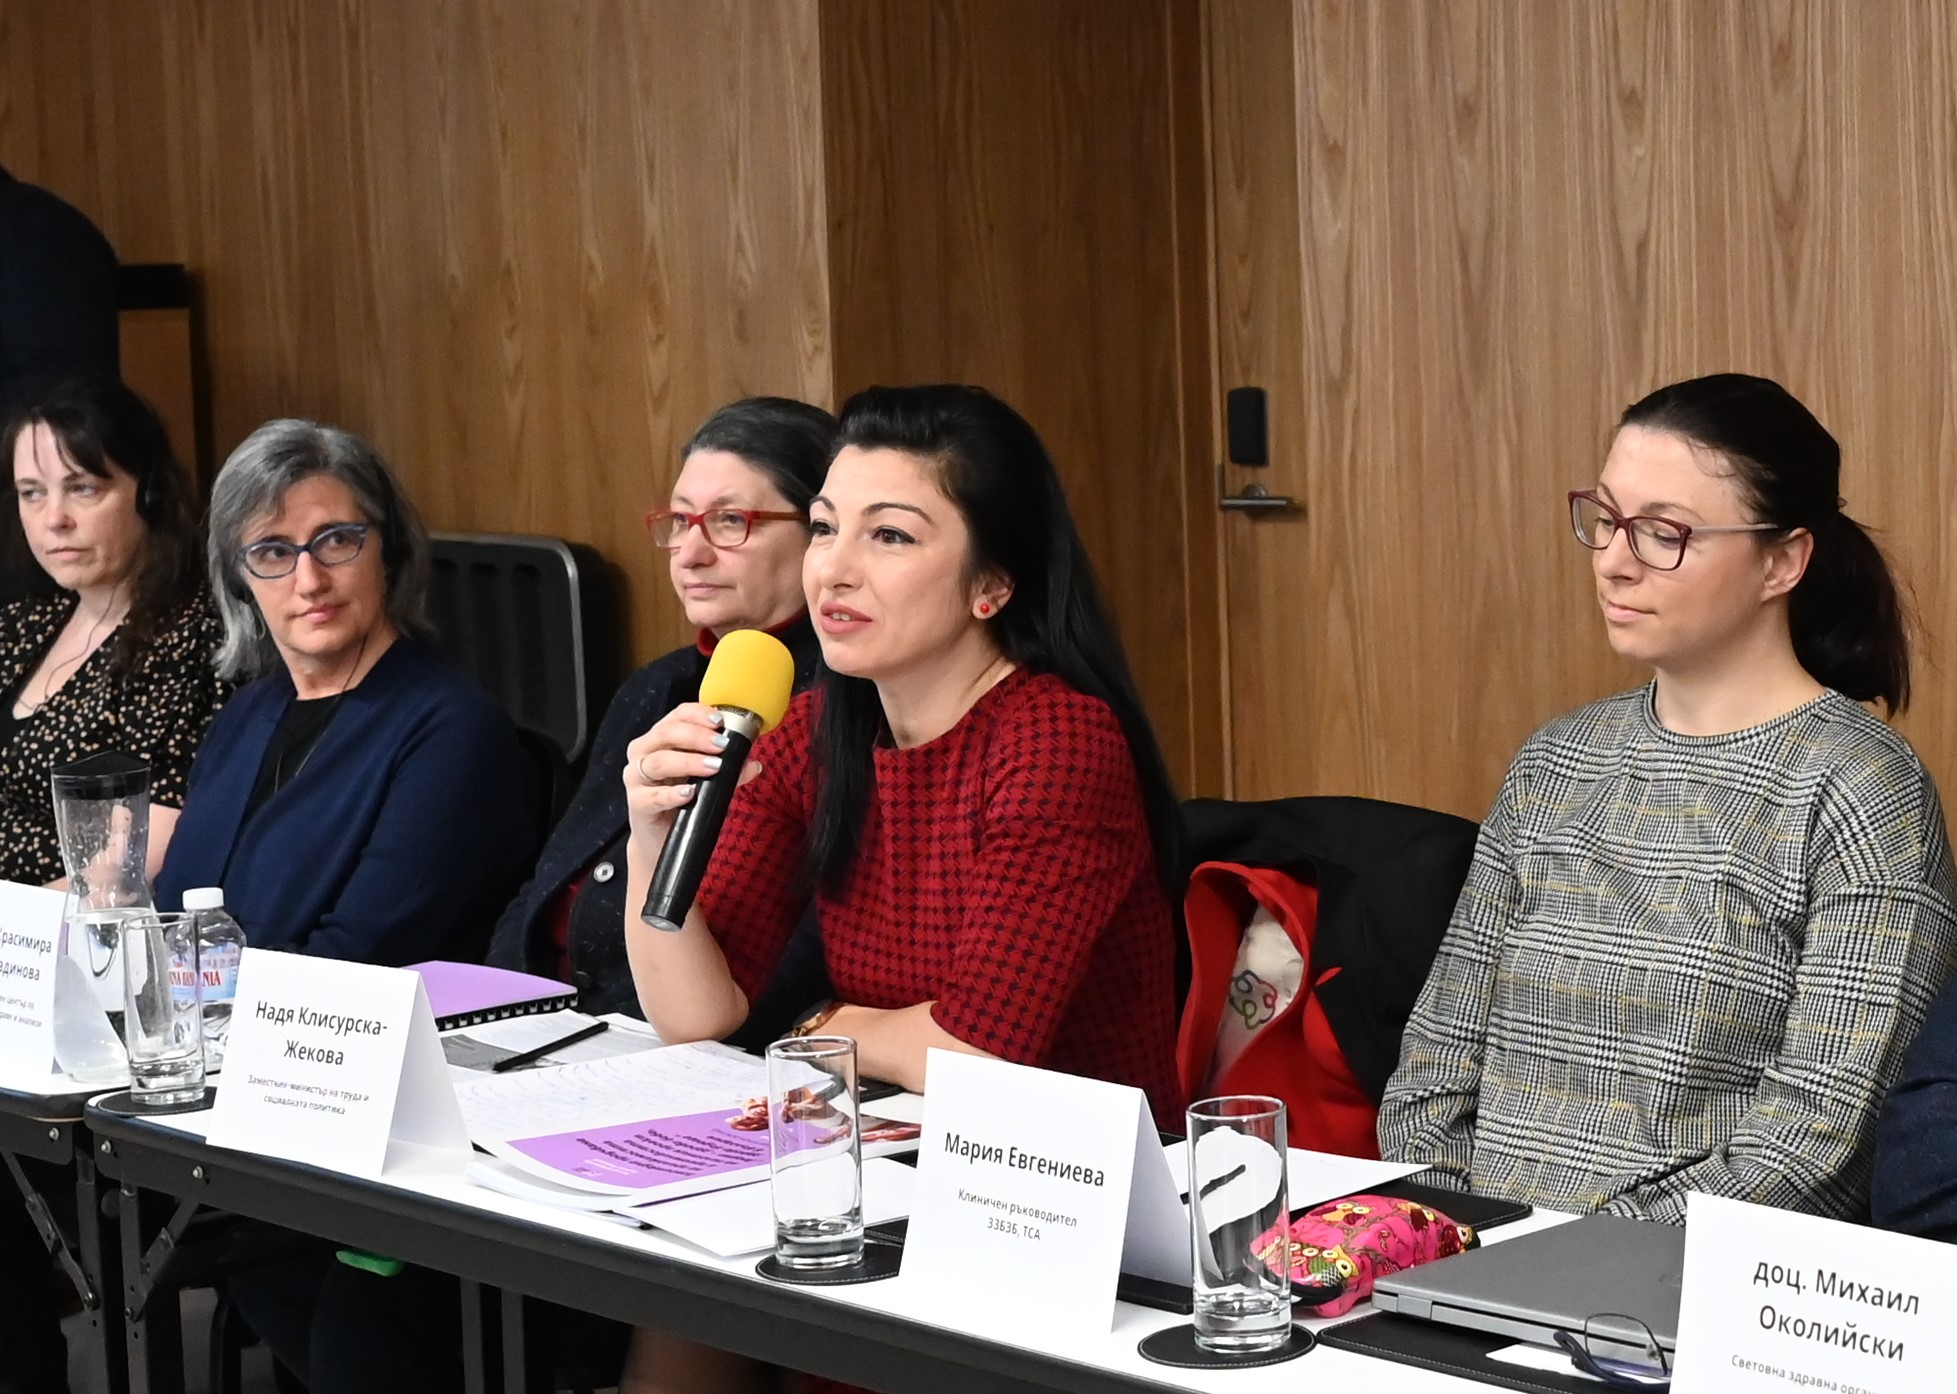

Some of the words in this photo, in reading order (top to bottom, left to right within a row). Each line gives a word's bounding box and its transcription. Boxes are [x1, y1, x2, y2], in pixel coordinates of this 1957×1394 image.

[0, 927, 52, 957] расимира
[256, 1000, 295, 1026] Надя
[298, 1006, 388, 1037] Клисурска-
[284, 1039, 345, 1065] Жекова
[945, 1132, 1003, 1165] Мария
[1008, 1146, 1105, 1187] Евгениева
[958, 1188, 1008, 1211] Клиничен
[1009, 1202, 1078, 1228] ръководител
[1753, 1261, 1807, 1295] доц.
[1815, 1268, 1920, 1315] Михаил
[1759, 1304, 1905, 1361] Околийски
[1731, 1354, 1786, 1379] Световна
[1788, 1371, 1838, 1391] здравна
